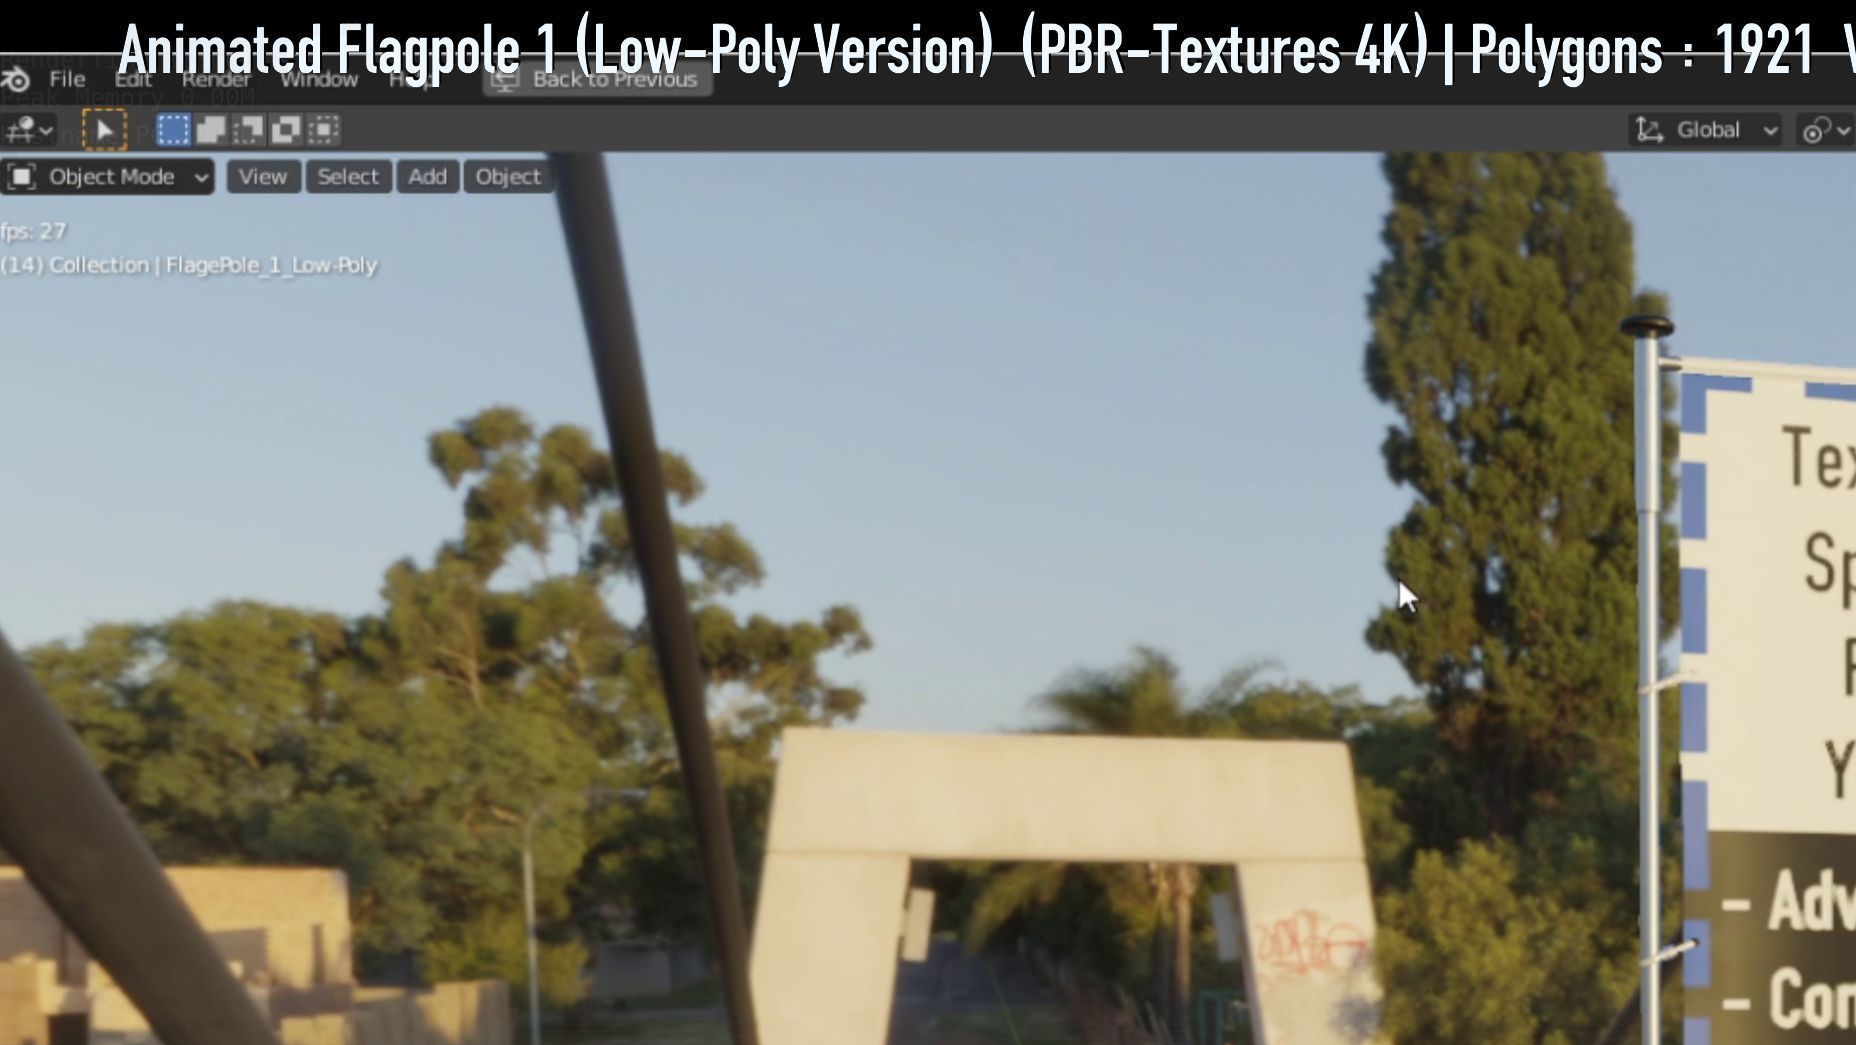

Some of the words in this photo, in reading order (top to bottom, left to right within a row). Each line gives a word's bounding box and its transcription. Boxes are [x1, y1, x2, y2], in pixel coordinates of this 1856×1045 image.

[50, 70, 86, 88] File
[115, 70, 153, 88] Edit
[182, 70, 252, 88] Render
[281, 70, 359, 88] Window
[534, 70, 582, 88] Back
[589, 72, 610, 88] to
[614, 70, 699, 88] Previous
[1677, 119, 1741, 140] Global
[50, 167, 115, 189] Object
[121, 167, 175, 185] Mode
[239, 167, 288, 186] View
[317, 167, 380, 186] Select
[408, 167, 448, 186] Add
[475, 167, 542, 189] Object
[0, 222, 34, 243] fps:
[40, 222, 67, 240] 27
[0, 256, 43, 276] (14)
[50, 256, 150, 275] Collection
[166, 256, 379, 279] FlagePole_1_Low-Poly
